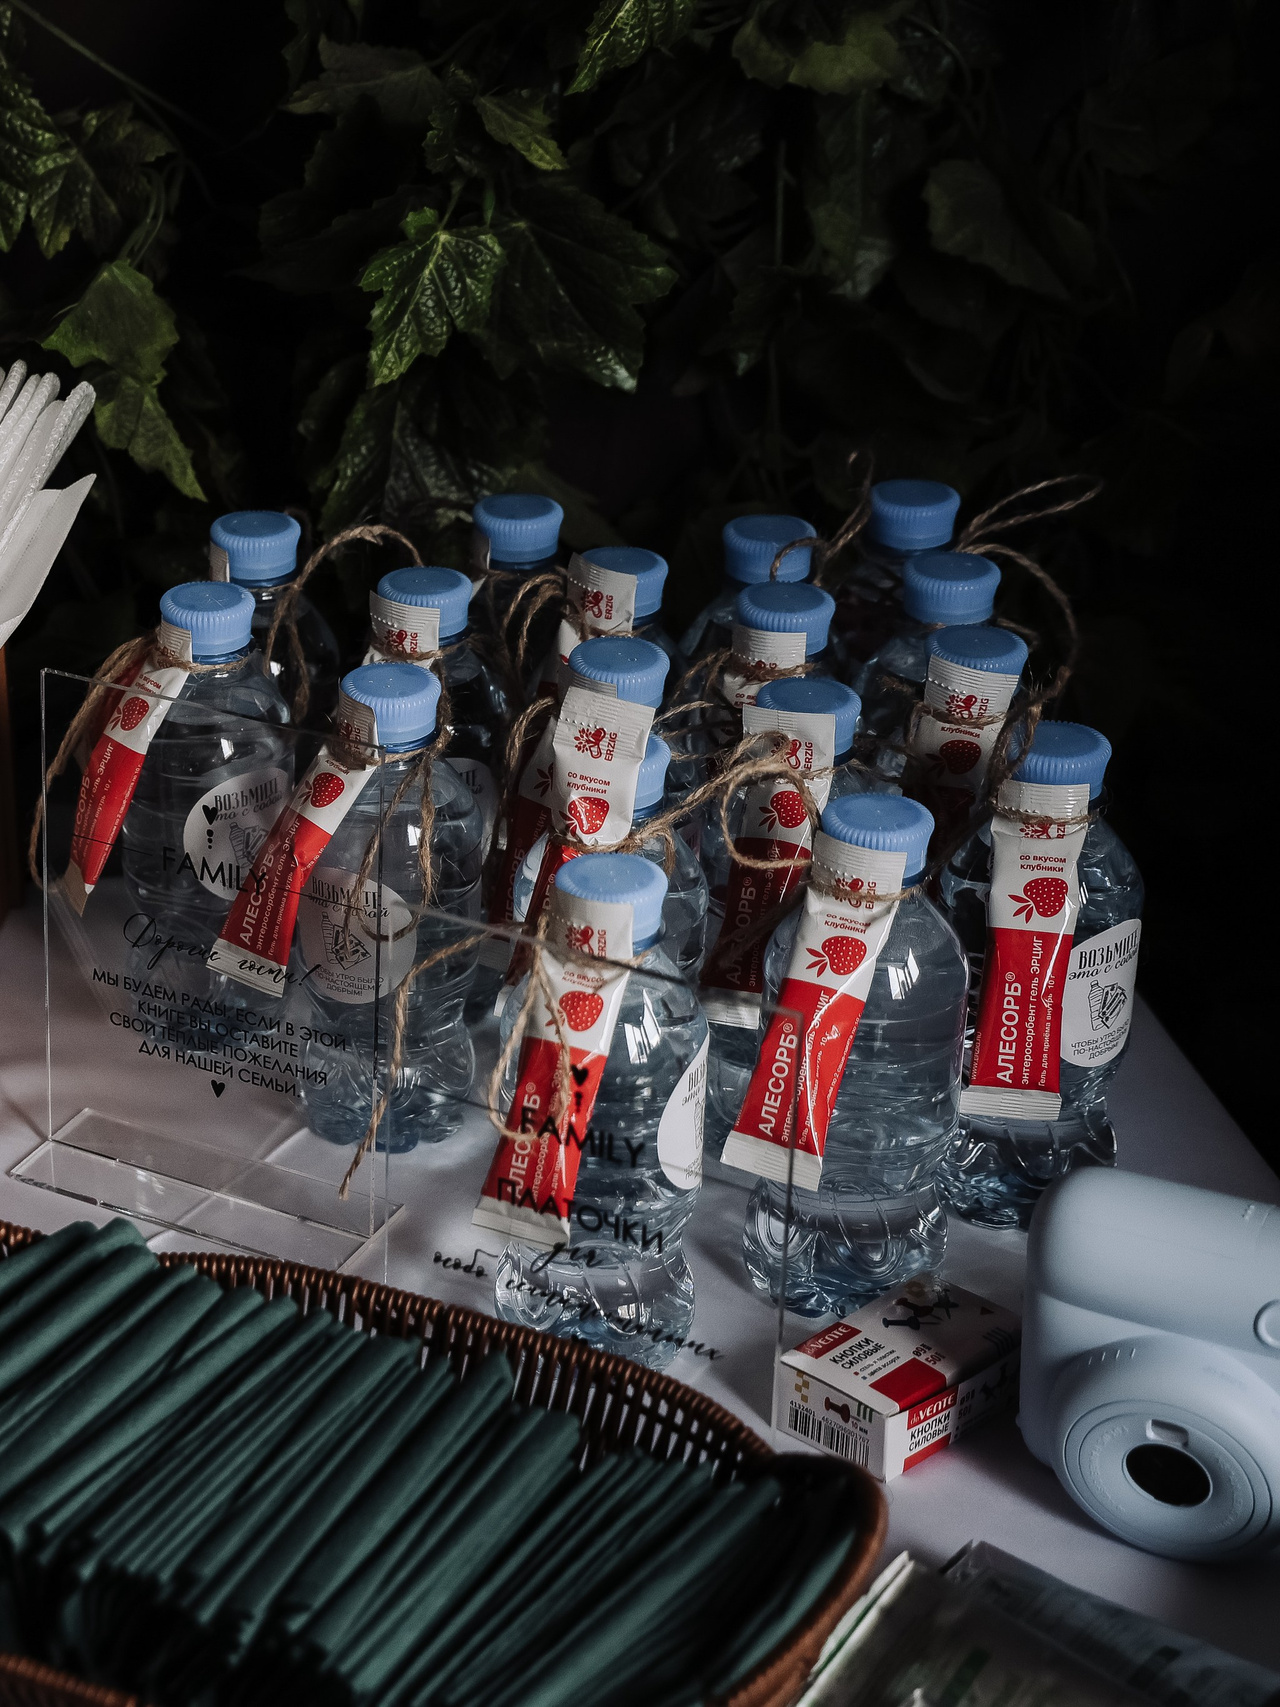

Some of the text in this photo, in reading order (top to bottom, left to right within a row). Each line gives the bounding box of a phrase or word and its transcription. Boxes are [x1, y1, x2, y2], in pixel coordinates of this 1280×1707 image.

[605, 595, 614, 620] ERZIG
[410, 632, 418, 654] RZIG
[977, 698, 989, 717] RZIG
[604, 732, 618, 762] ERZIG
[804, 741, 814, 769] ERZIG
[566, 781, 607, 795] клубники
[567, 771, 611, 787] со вкусом
[214, 811, 238, 821] то
[162, 846, 266, 895] FAMILY
[1020, 864, 1064, 873] клубники
[1033, 856, 1067, 864] вкусом
[824, 920, 867, 934] клубники
[1068, 968, 1102, 981] это
[92, 967, 119, 987] МЫ
[123, 976, 177, 1003] БУДЕМ
[236, 1008, 280, 1033] ЕСЛИ
[285, 1021, 295, 1036] В
[299, 1026, 346, 1051] ЭТОЙ
[1021, 935, 1043, 1085] энтеросорбент гель ЭРЦИГ
[138, 1000, 298, 1058] КНИГЕ ВЫ ОСТАВИТЕ
[109, 1011, 327, 1086] СВОИ ТЁПЛЫЕ ПОЖЕЛАНИЯ
[138, 1040, 301, 1098] ДЛЯ НАШЕЙ СЕМЬИ.
[520, 1105, 647, 1169] FAMILY
[497, 1176, 664, 1255] ПЛАТОЧКИ
[829, 1337, 875, 1365] КНОПКИ
[841, 1342, 886, 1370] СИЛОВЫЕ
[908, 1422, 949, 1452] СИЛОВЫЕ
[910, 1410, 951, 1441] КНОПКИ
